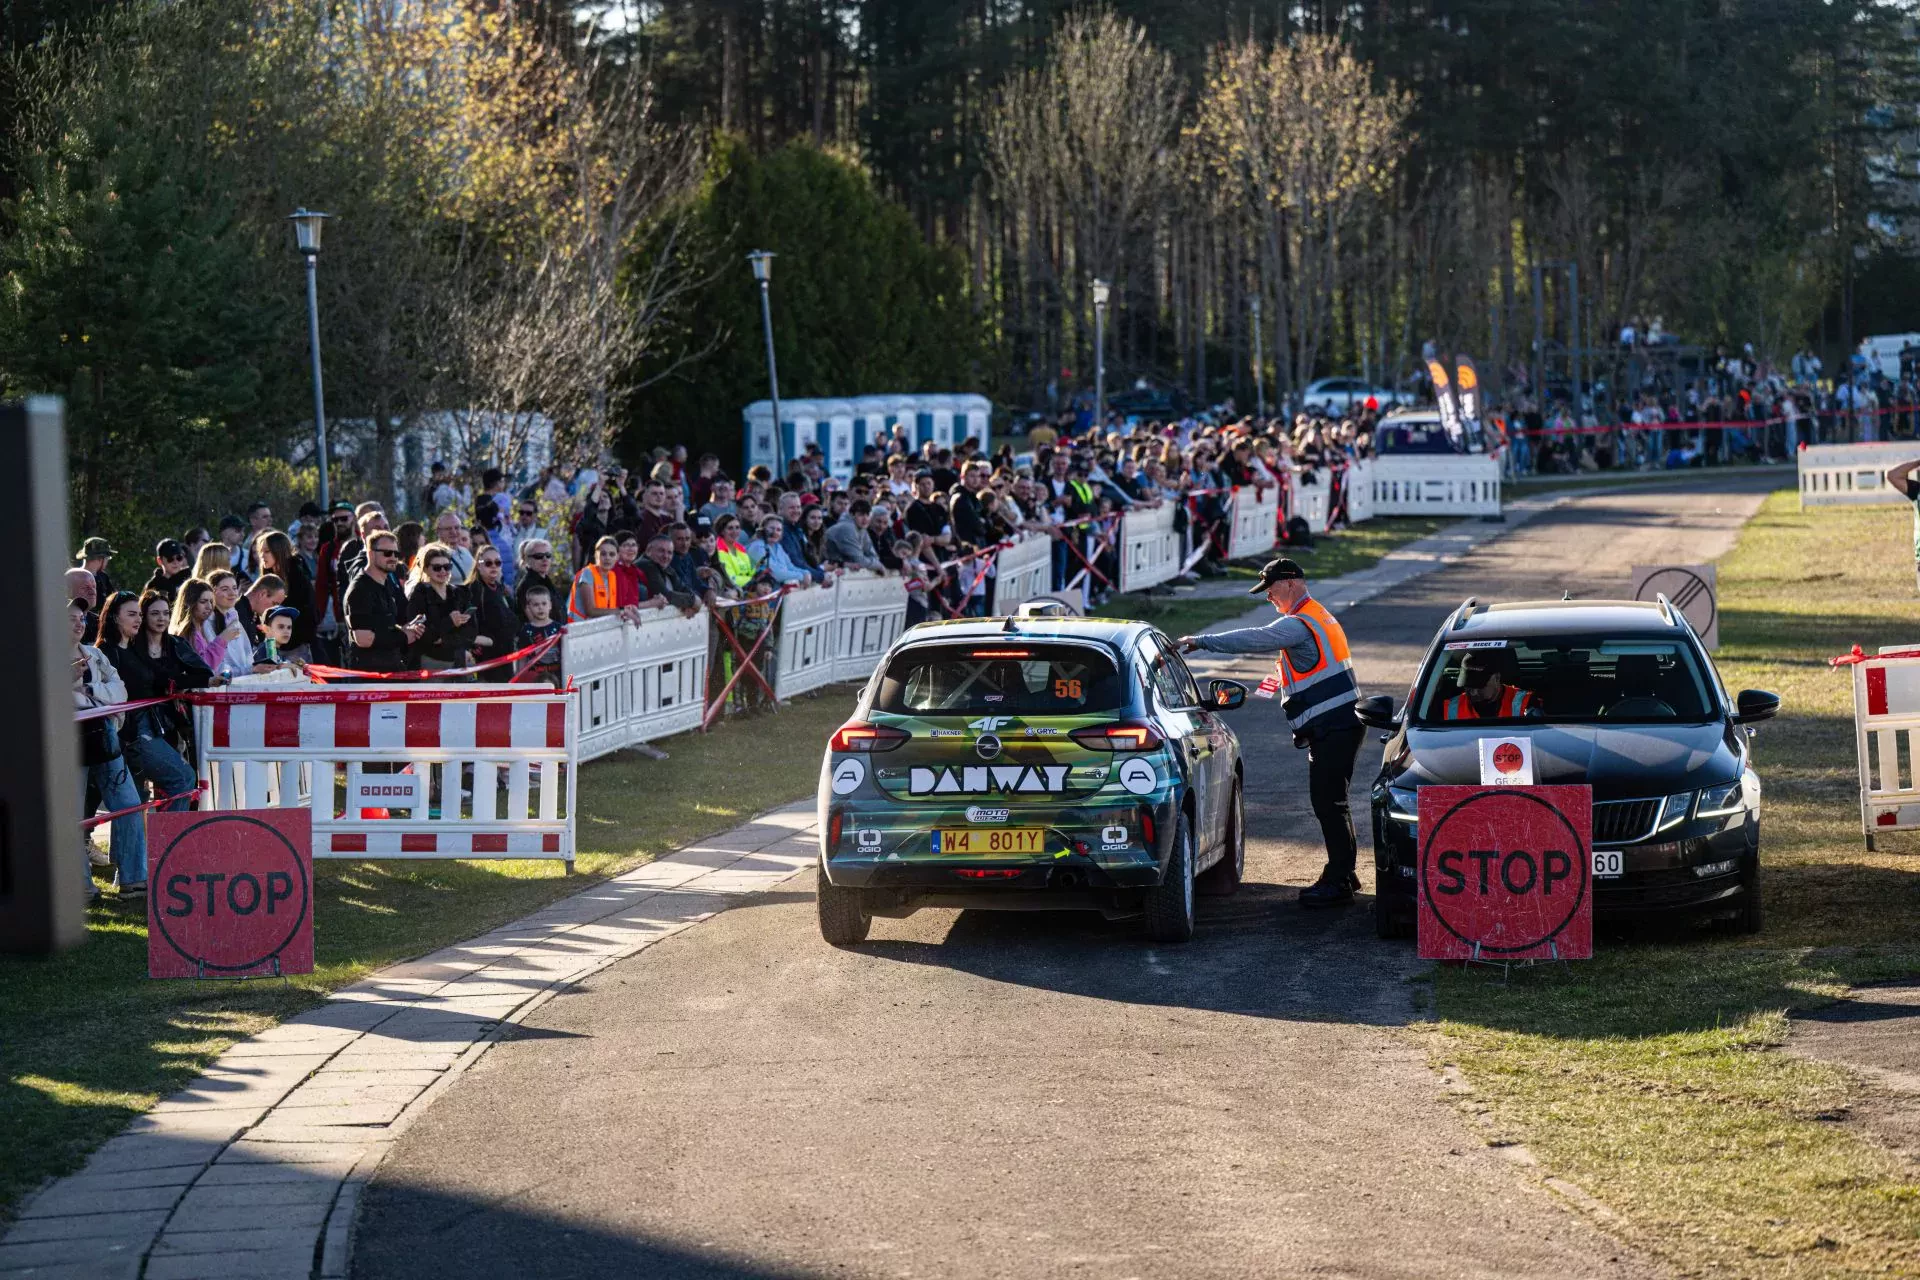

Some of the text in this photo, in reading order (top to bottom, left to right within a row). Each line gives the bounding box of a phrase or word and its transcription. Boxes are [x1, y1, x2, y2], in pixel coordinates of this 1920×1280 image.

[346, 692, 390, 702] STOP
[1055, 679, 1081, 698] 56
[968, 716, 1013, 731] 4F
[1495, 754, 1521, 762] STOP
[911, 766, 1068, 792] DANWAY
[361, 785, 413, 796] CRAMO
[944, 832, 1038, 851] W4 801Y
[1101, 843, 1129, 851] OGIO
[1437, 850, 1572, 896] STOP
[1594, 854, 1619, 873] 60
[166, 871, 294, 917] STOP
